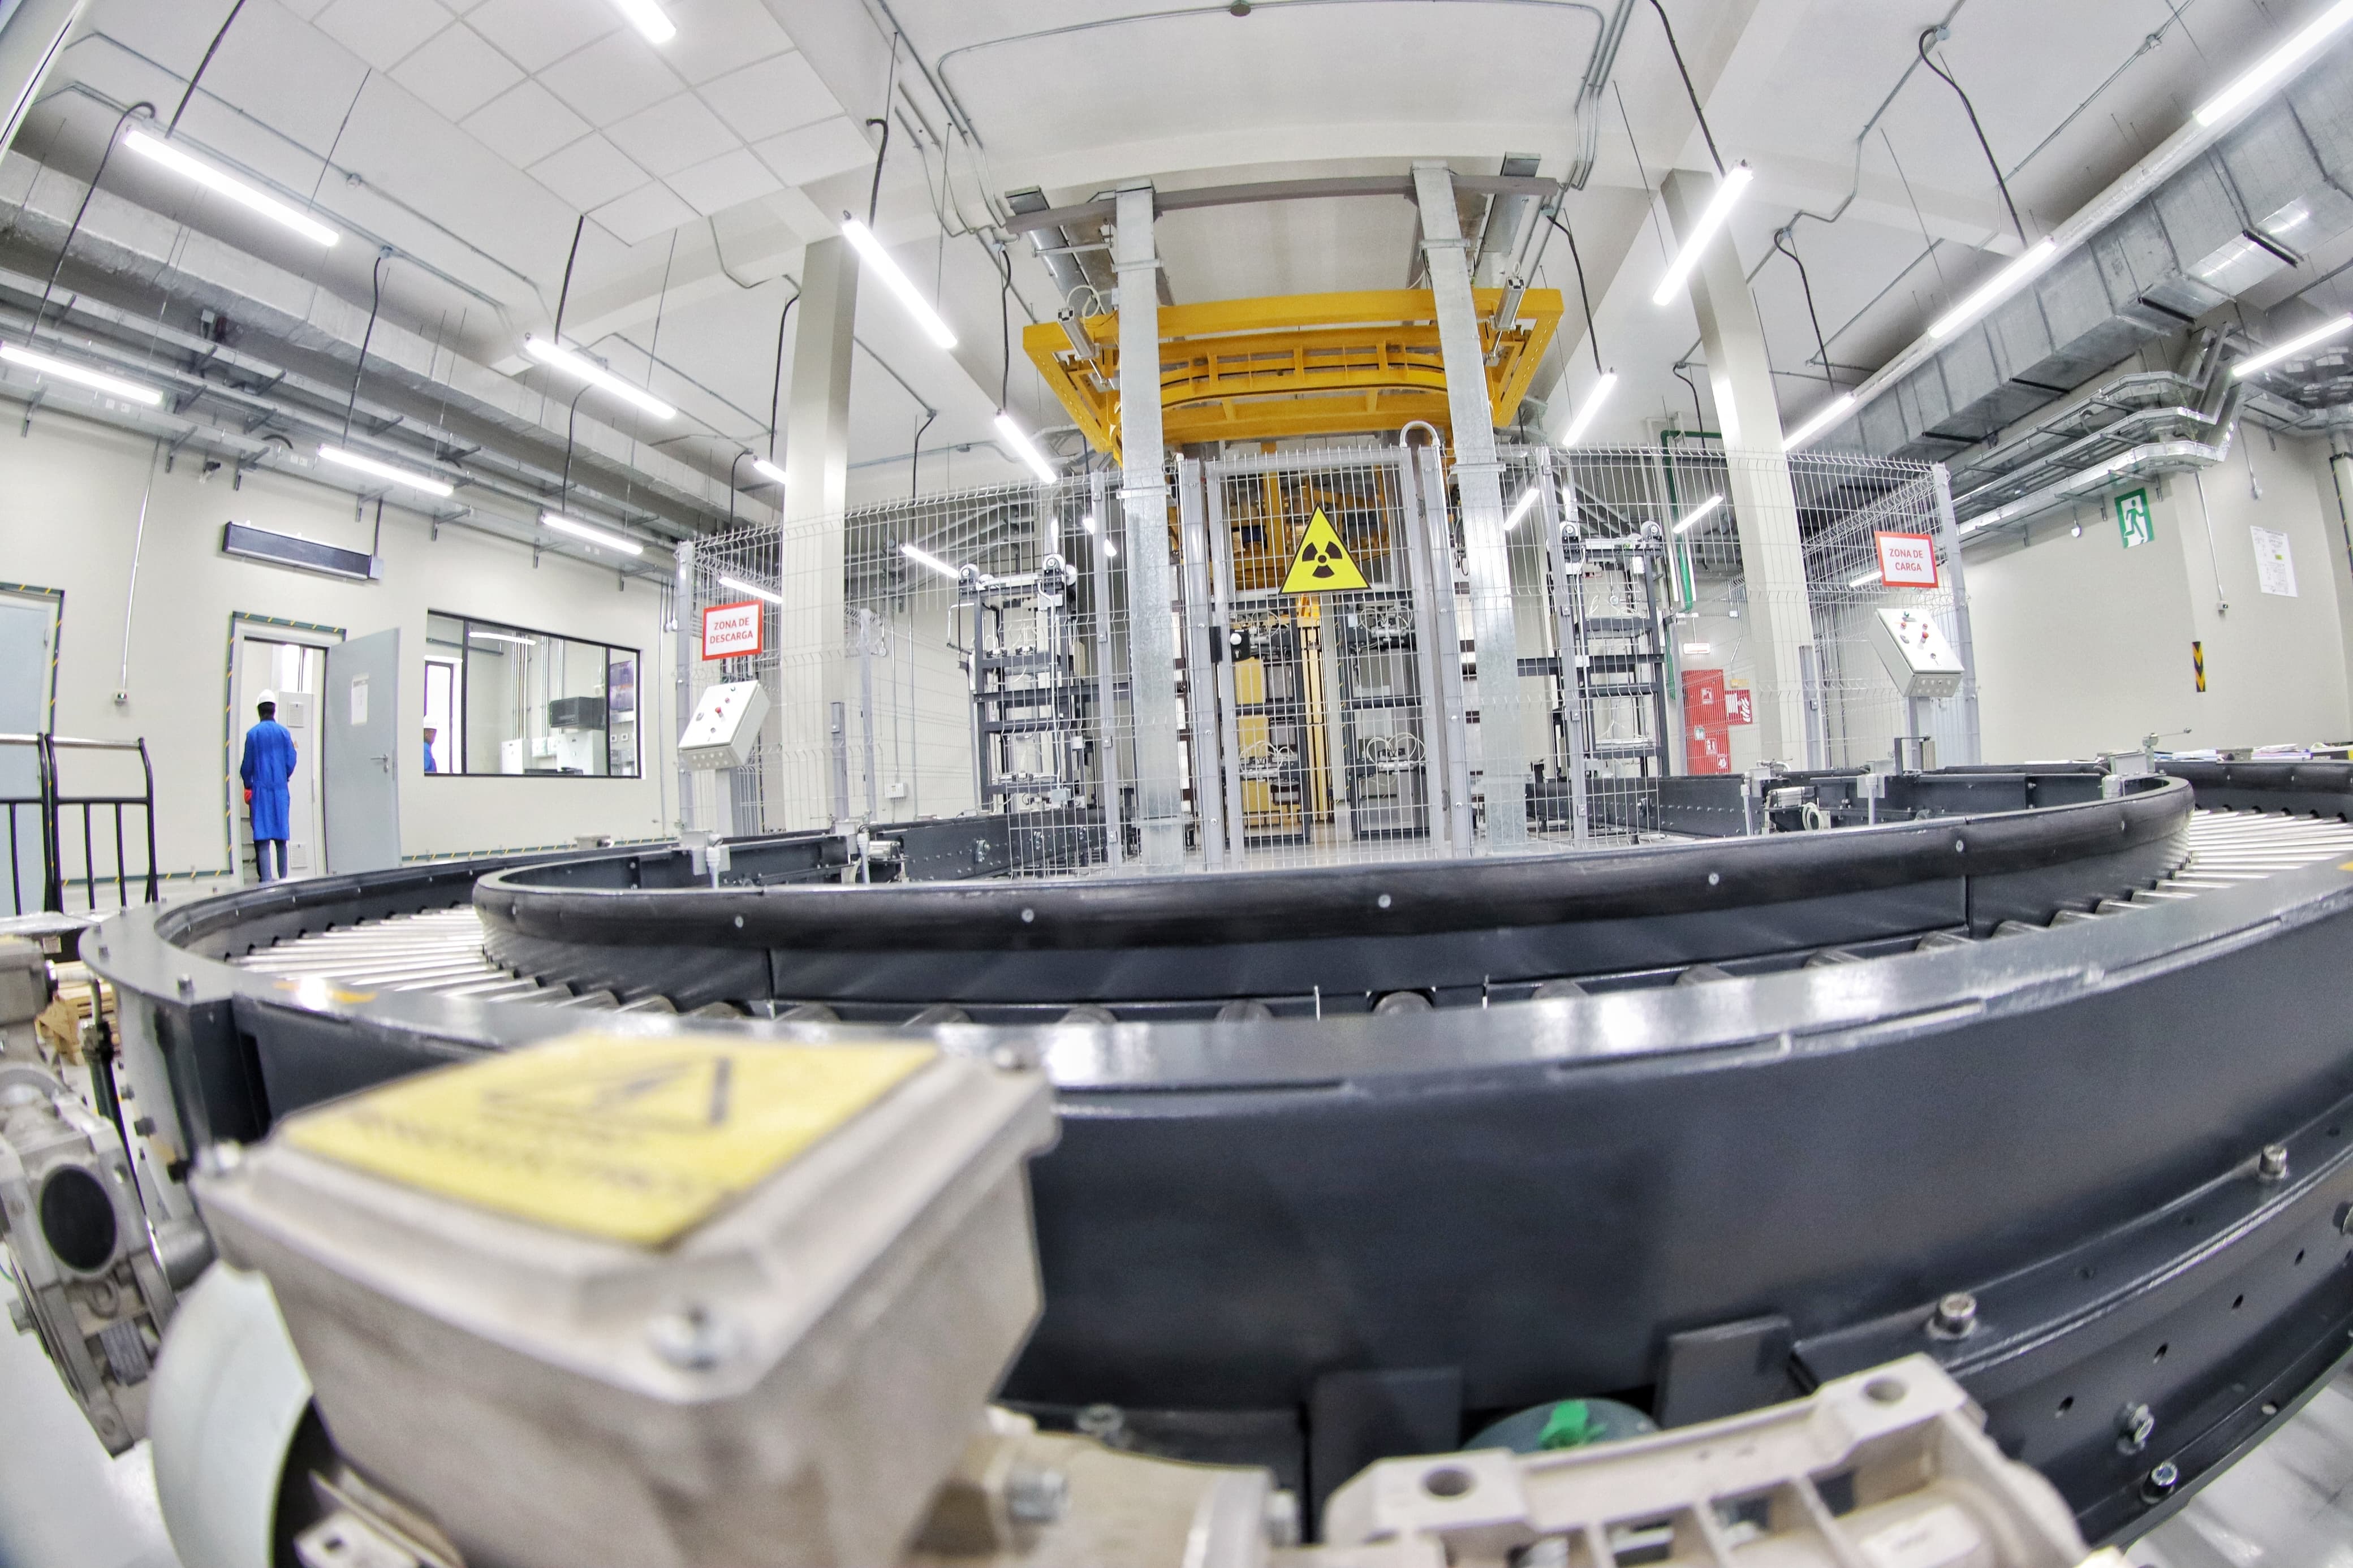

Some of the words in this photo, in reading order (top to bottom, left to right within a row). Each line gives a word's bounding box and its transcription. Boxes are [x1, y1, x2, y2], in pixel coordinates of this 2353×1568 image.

[1889, 548, 1912, 558] ZONA
[1913, 550, 1924, 559] DE
[1895, 562, 1922, 571] CARGA
[714, 620, 737, 631] ZONA
[739, 617, 749, 627] DE
[710, 630, 753, 643] DESCARGA
